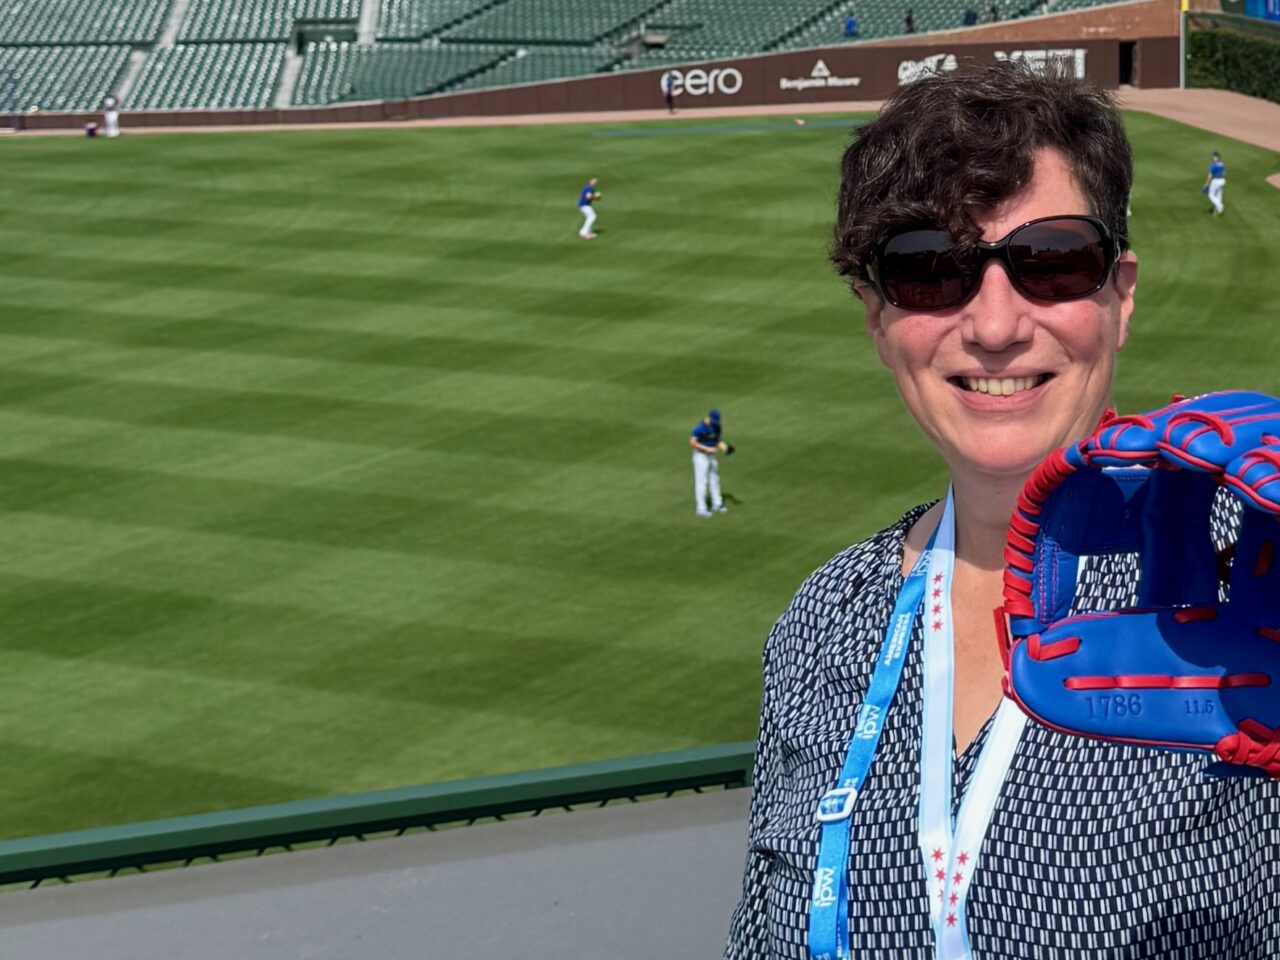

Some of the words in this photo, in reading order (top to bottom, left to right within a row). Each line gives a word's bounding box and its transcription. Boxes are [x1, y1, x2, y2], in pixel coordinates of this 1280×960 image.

[660, 68, 743, 96] eero
[1085, 693, 1142, 720] 1786
[1184, 698, 1214, 716] 11.5
